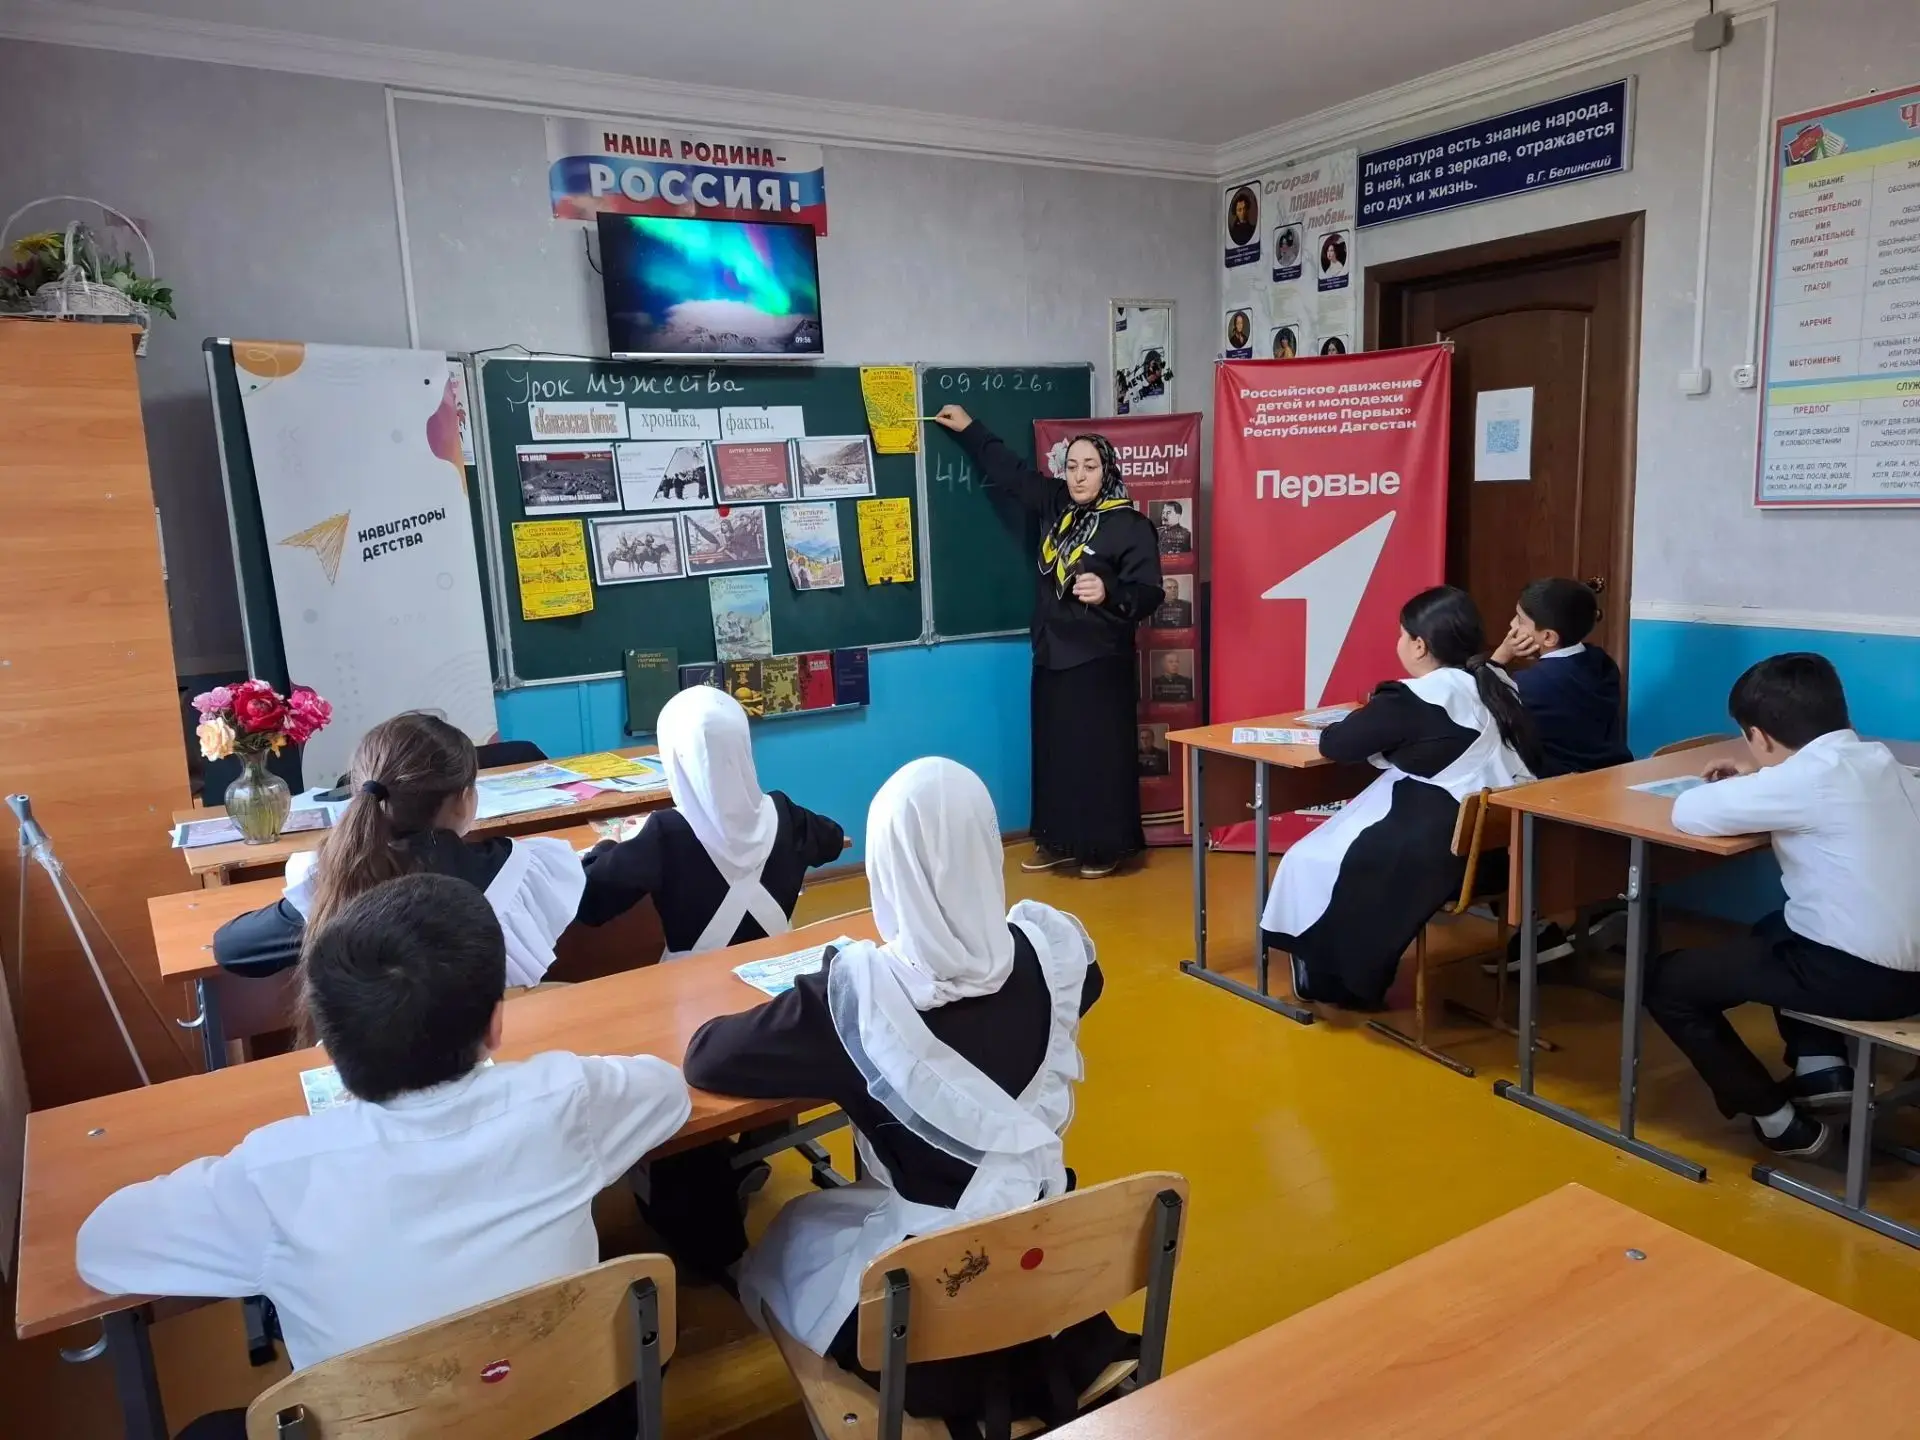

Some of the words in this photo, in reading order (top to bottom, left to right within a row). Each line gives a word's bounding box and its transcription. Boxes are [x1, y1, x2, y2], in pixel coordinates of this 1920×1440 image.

[603, 132, 673, 158] НАША
[1364, 145, 1444, 177] Литература
[1447, 136, 1481, 155] есть
[1485, 120, 1541, 144] знание
[1545, 100, 1614, 129] народа.
[1364, 181, 1374, 196] В
[1377, 173, 1405, 194] ней,
[1409, 169, 1431, 183] как
[1435, 167, 1444, 178] в
[1447, 151, 1512, 176] зеркале,
[1516, 121, 1615, 158] отражается
[1548, 154, 1613, 181] Белинский
[588, 163, 801, 214] РОССИЯ!
[1264, 169, 1321, 195] Сгорая
[1808, 175, 1845, 189] НАЗВАНИЕ
[1289, 182, 1345, 213] пламенем
[1363, 200, 1385, 215] его
[1387, 193, 1413, 212] дух
[1416, 190, 1425, 202] и
[1428, 180, 1478, 201] жизнь.
[1817, 191, 1834, 202] ИМЯ
[1788, 198, 1862, 220] СУЩЕСТВИТЕЛЬНОЕ
[1815, 220, 1832, 231] ИМЯ
[1790, 228, 1856, 247] ПРИЛАГАТЕЛЬНОЕ
[1812, 248, 1829, 258] ИМЯ
[1791, 257, 1849, 273] ЧИСЛИТЕЛЬНОЕ
[1803, 281, 1832, 293] ГЛАГОЛ
[1799, 316, 1833, 328] НАРЕЧИЕ
[1788, 355, 1841, 368] МЕСТОИМЕНИЕ
[506, 369, 575, 411] Урок
[1240, 385, 1336, 399] Российское
[1338, 378, 1423, 394] движение
[1256, 396, 1302, 413] детей
[1305, 398, 1315, 408] и
[1318, 393, 1404, 410] молодежи
[1793, 404, 1831, 415] ПРЕДЛОГ
[641, 412, 701, 432] хроника,
[725, 413, 775, 435] факты,
[1249, 411, 1338, 426] «Движение
[1340, 407, 1412, 422] Первых»
[1243, 425, 1338, 438] Республики
[1339, 419, 1417, 435] Дагестан
[1113, 443, 1188, 460] АРШАЛЫ
[1115, 461, 1169, 478] БЕДЫ
[1256, 470, 1401, 508] Первые
[357, 507, 447, 544] НАВИГАТОРЫ
[362, 532, 424, 562] ДЕТСТВА
